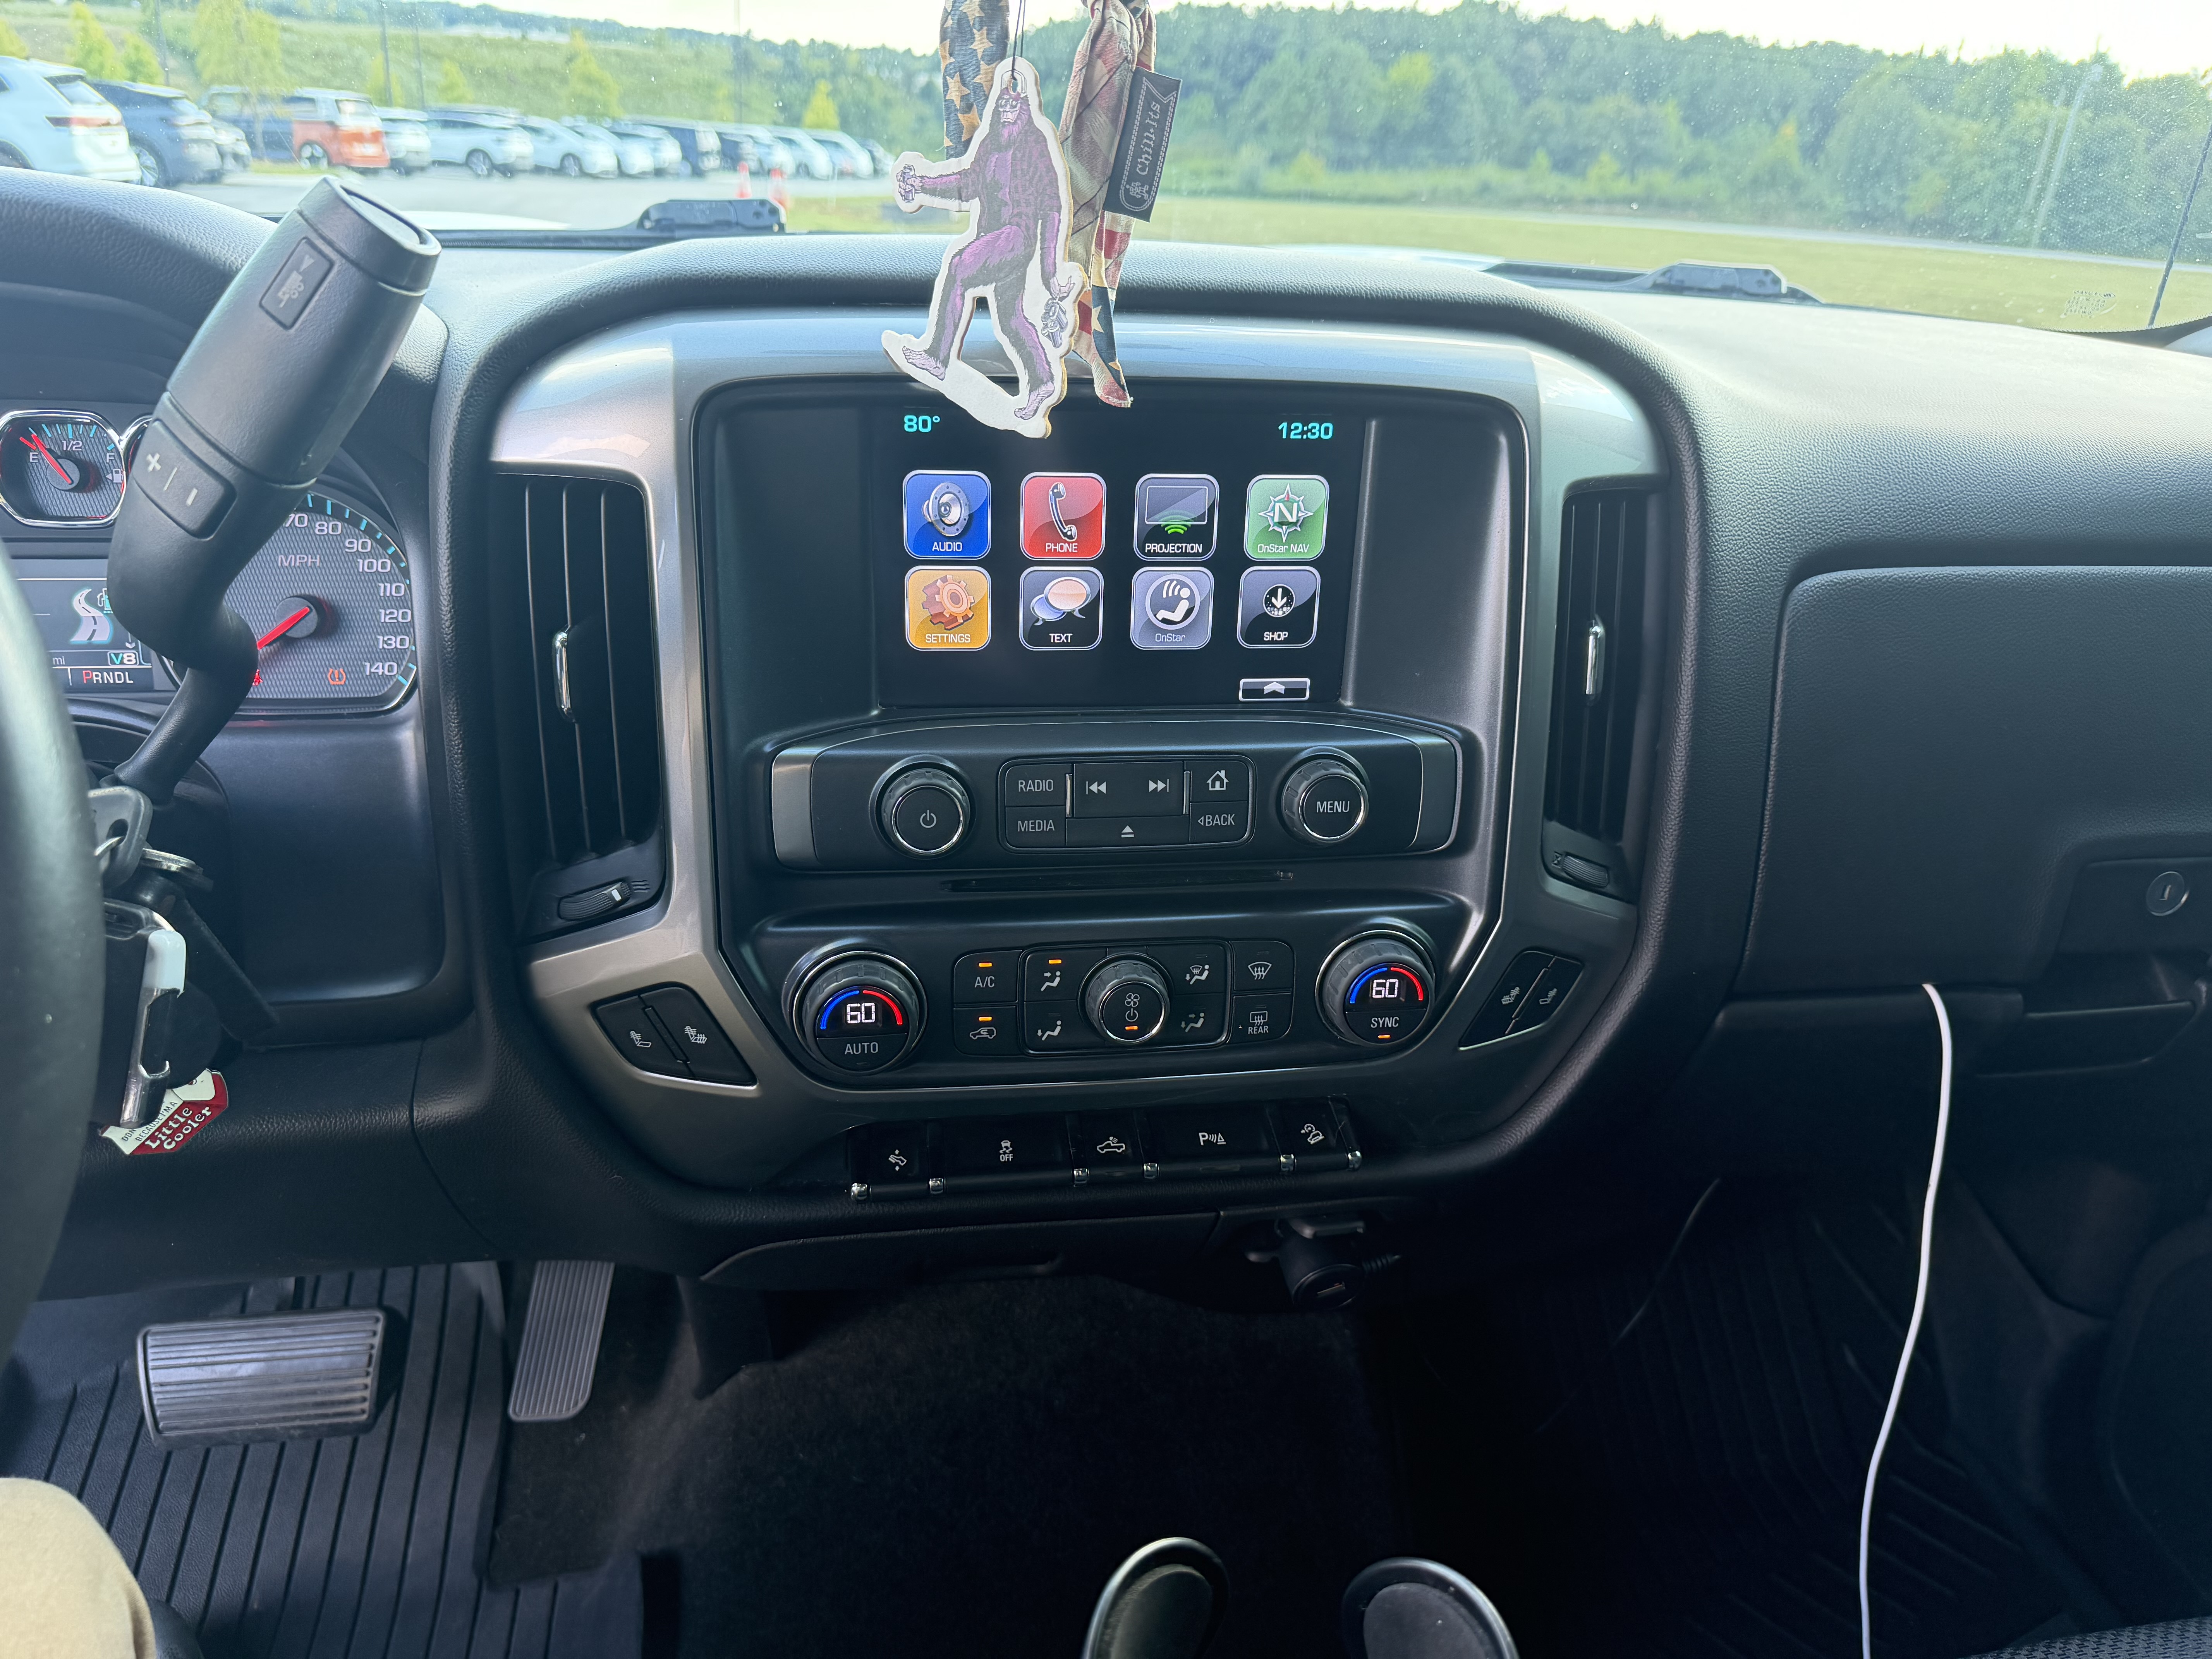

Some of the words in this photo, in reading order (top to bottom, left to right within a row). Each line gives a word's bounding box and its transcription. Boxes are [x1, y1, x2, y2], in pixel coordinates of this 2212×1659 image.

[903, 414, 941, 433] 80°
[1278, 422, 1333, 440] 12:30
[62, 441, 82, 451] 1/2
[29, 452, 39, 462] E
[106, 453, 115, 463] F
[285, 513, 309, 527] 70
[315, 521, 342, 535] 80
[345, 538, 372, 553] 90
[931, 541, 963, 552] AUDIO
[1045, 543, 1078, 553] PHONE
[1145, 543, 1202, 553] PROJECTION
[1257, 543, 1288, 553] OnStar
[1290, 543, 1310, 553] NAV
[278, 555, 321, 567] MPH
[357, 558, 392, 573] 100
[378, 582, 405, 597] 110
[379, 608, 412, 623] 120
[377, 635, 410, 649] 130
[925, 634, 971, 644] SETTINGS
[1049, 633, 1073, 643] TEXT
[1155, 633, 1186, 642] OnStar
[1263, 631, 1289, 641] SHOP
[52, 656, 65, 665] mi
[110, 652, 137, 665] V8
[364, 661, 398, 675] 140
[82, 670, 134, 684] PRNDL
[1018, 779, 1054, 792] RADIO
[1316, 800, 1350, 813] MENU
[1017, 819, 1055, 832] MEDIA
[1205, 814, 1235, 826] BACK
[974, 976, 995, 988] A/C
[1372, 979, 1399, 998] 60
[847, 1002, 876, 1024] 60
[1370, 1017, 1400, 1028] SYNC
[1248, 1025, 1269, 1034] REAR
[844, 1042, 879, 1055] AUTO
[135, 1116, 163, 1141] BECAUSE
[170, 1101, 178, 1109] A
[121, 1128, 137, 1141] DON
[145, 1107, 193, 1149] Little
[163, 1106, 212, 1150] Cooler
[1000, 1154, 1013, 1162] OFF
